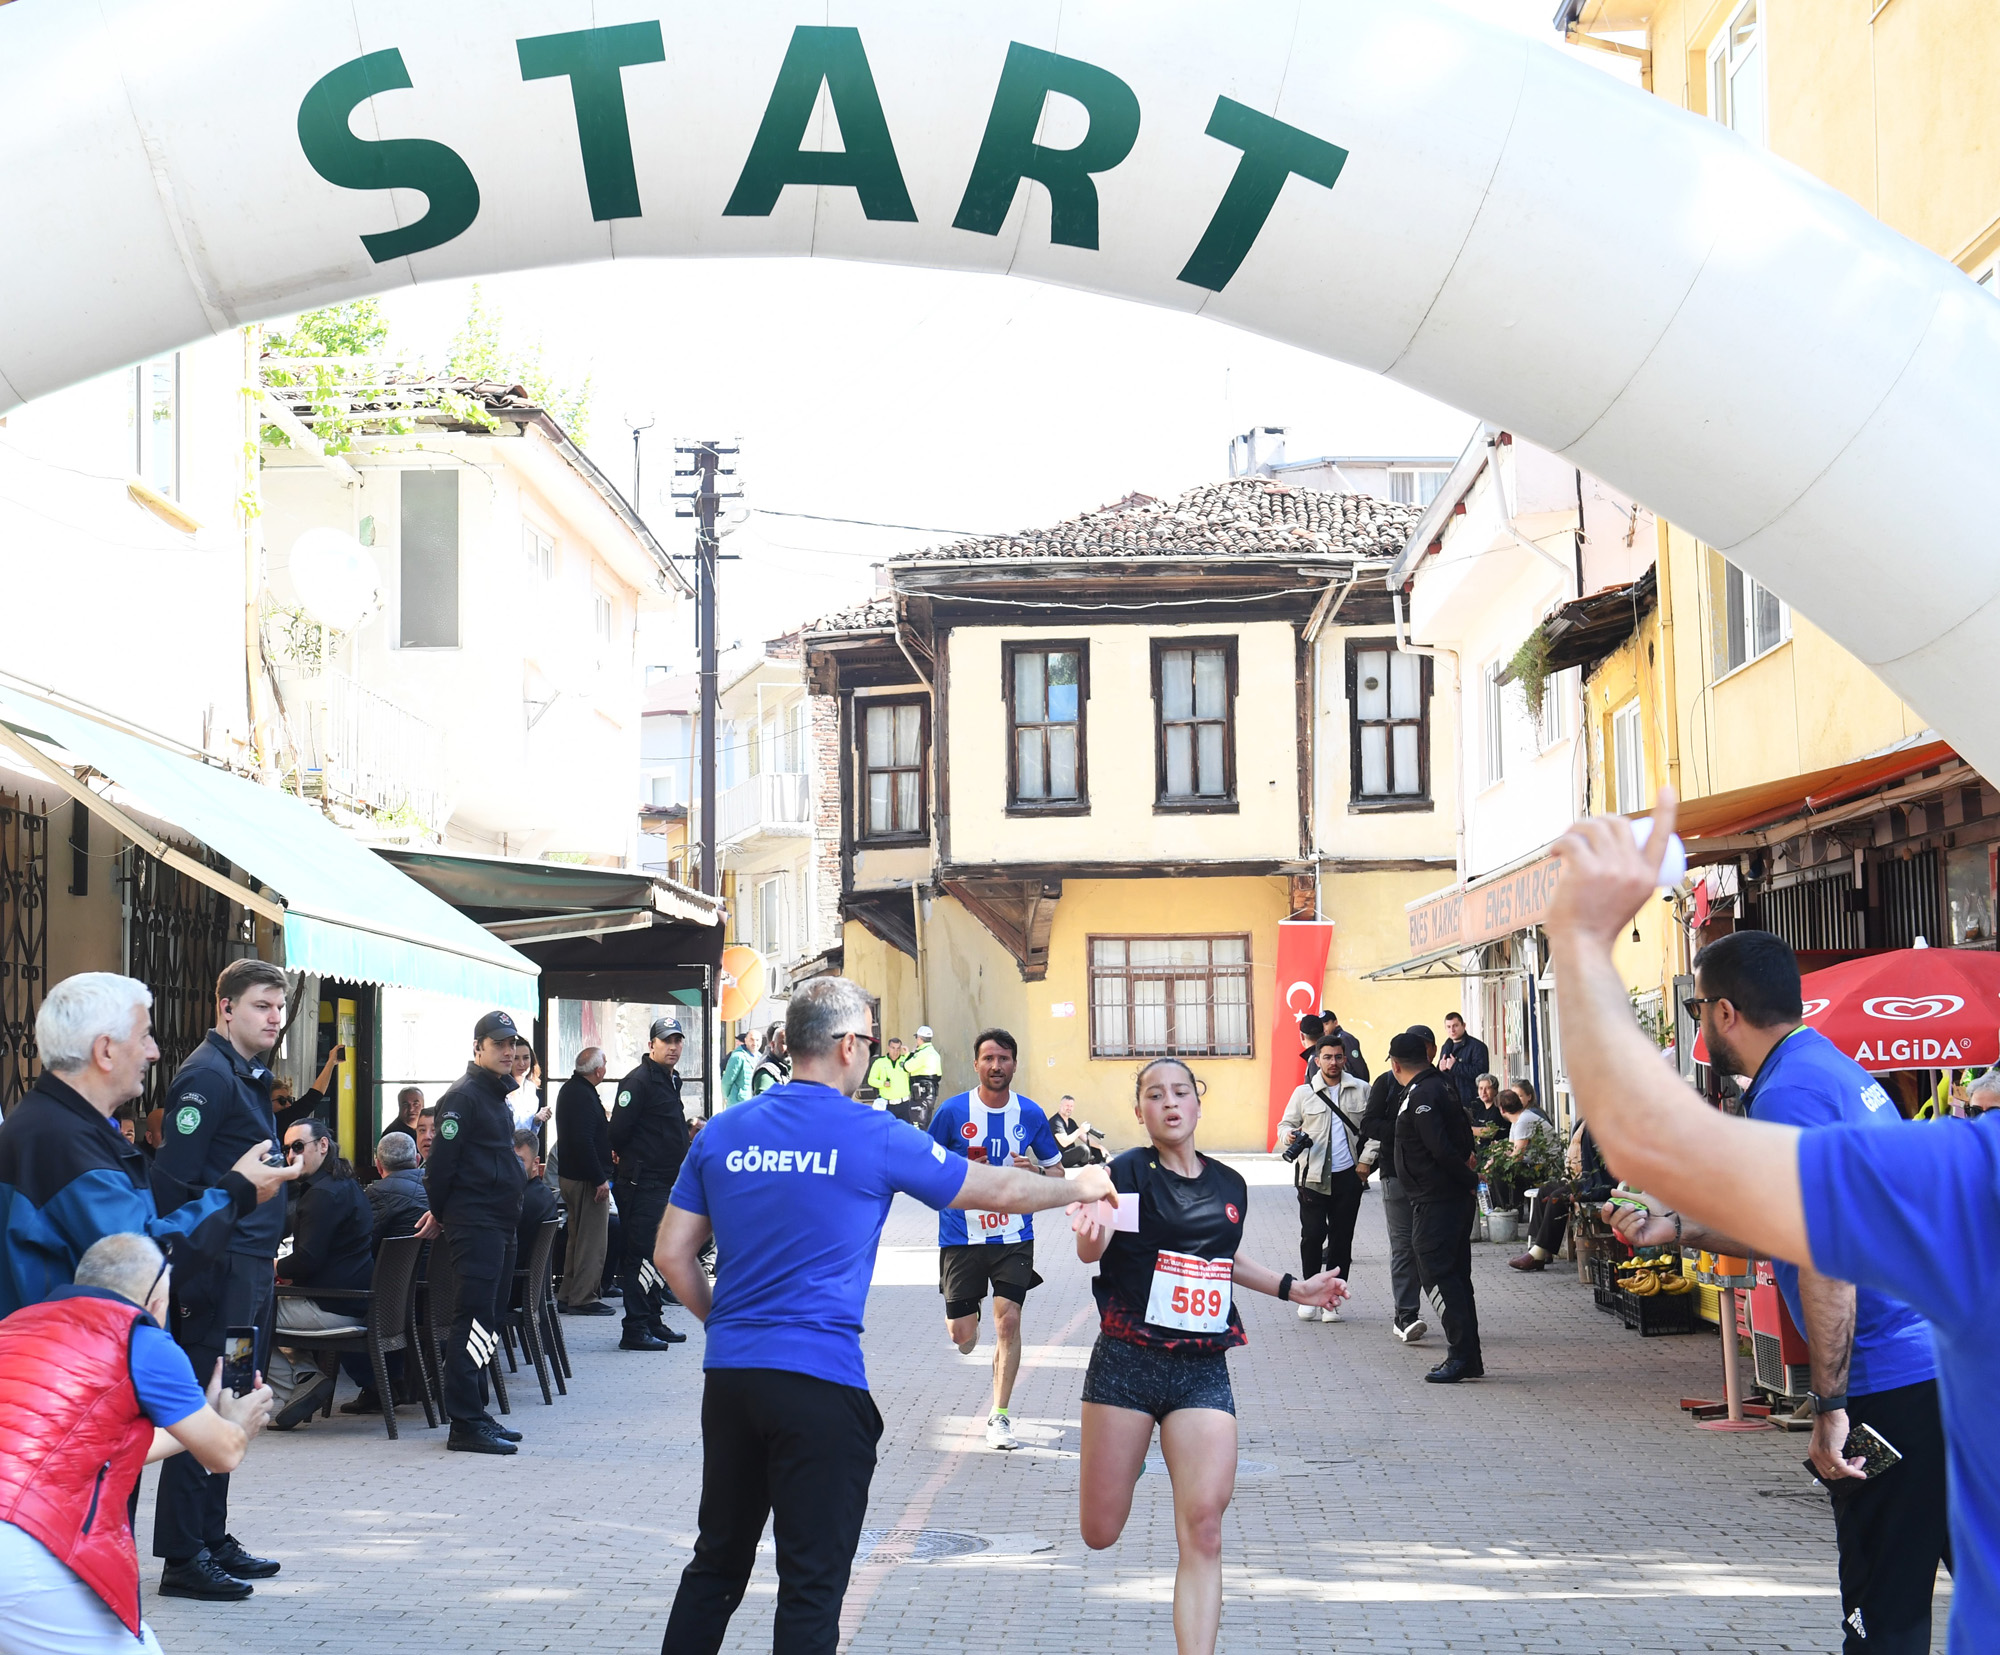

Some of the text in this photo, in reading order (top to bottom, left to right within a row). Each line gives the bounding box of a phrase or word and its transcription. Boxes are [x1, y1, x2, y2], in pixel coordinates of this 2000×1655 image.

[297, 19, 1349, 292] START
[1409, 896, 1463, 947] ENES MARKET
[1485, 884, 1513, 930] ENES
[726, 1145, 838, 1175] GÖREVLİ
[991, 1138, 1001, 1157] 11
[978, 1212, 1009, 1230] 100
[1171, 1286, 1222, 1317] 589
